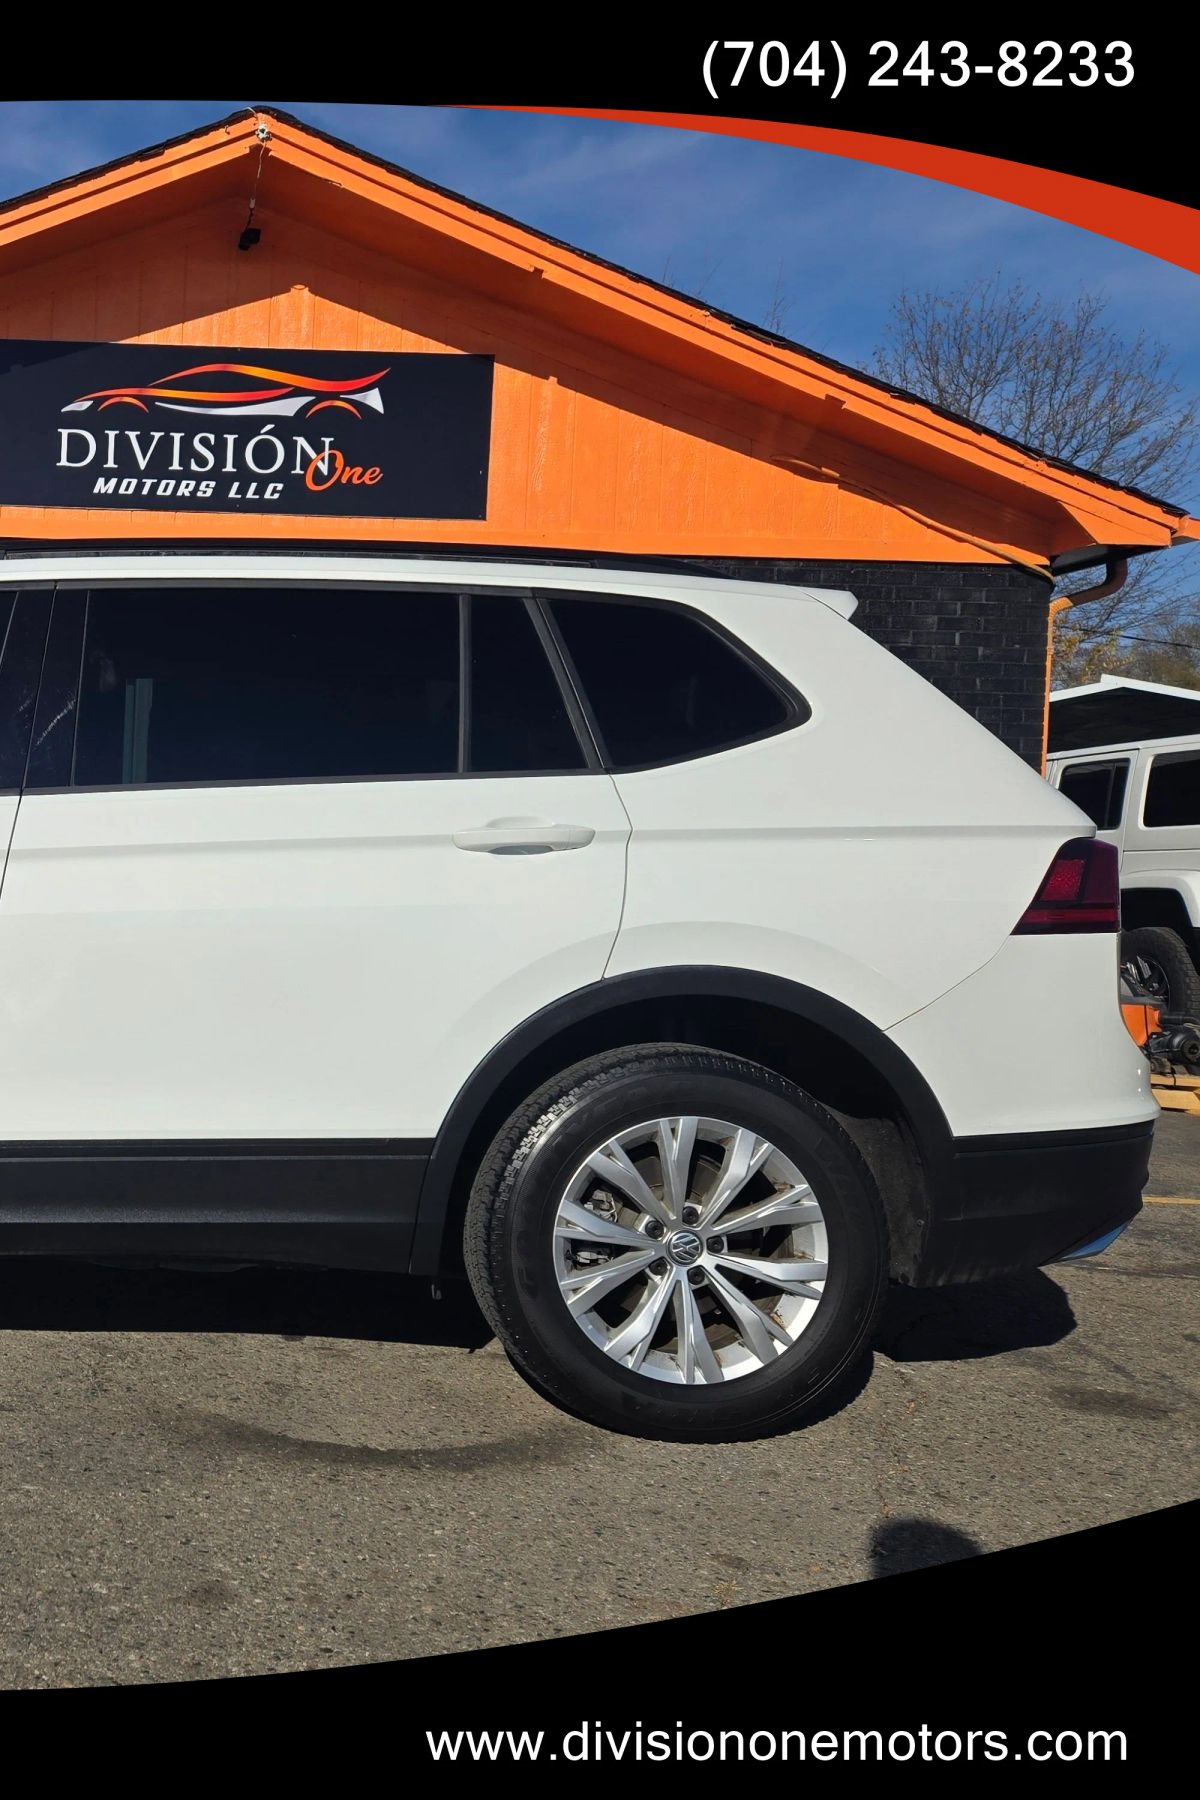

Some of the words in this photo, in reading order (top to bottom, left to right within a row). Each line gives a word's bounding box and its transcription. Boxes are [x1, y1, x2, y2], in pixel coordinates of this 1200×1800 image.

[55, 424, 335, 476] DIVISIÓN
[303, 449, 384, 492] One
[92, 477, 217, 498] MOTORS
[228, 482, 284, 500] LLC
